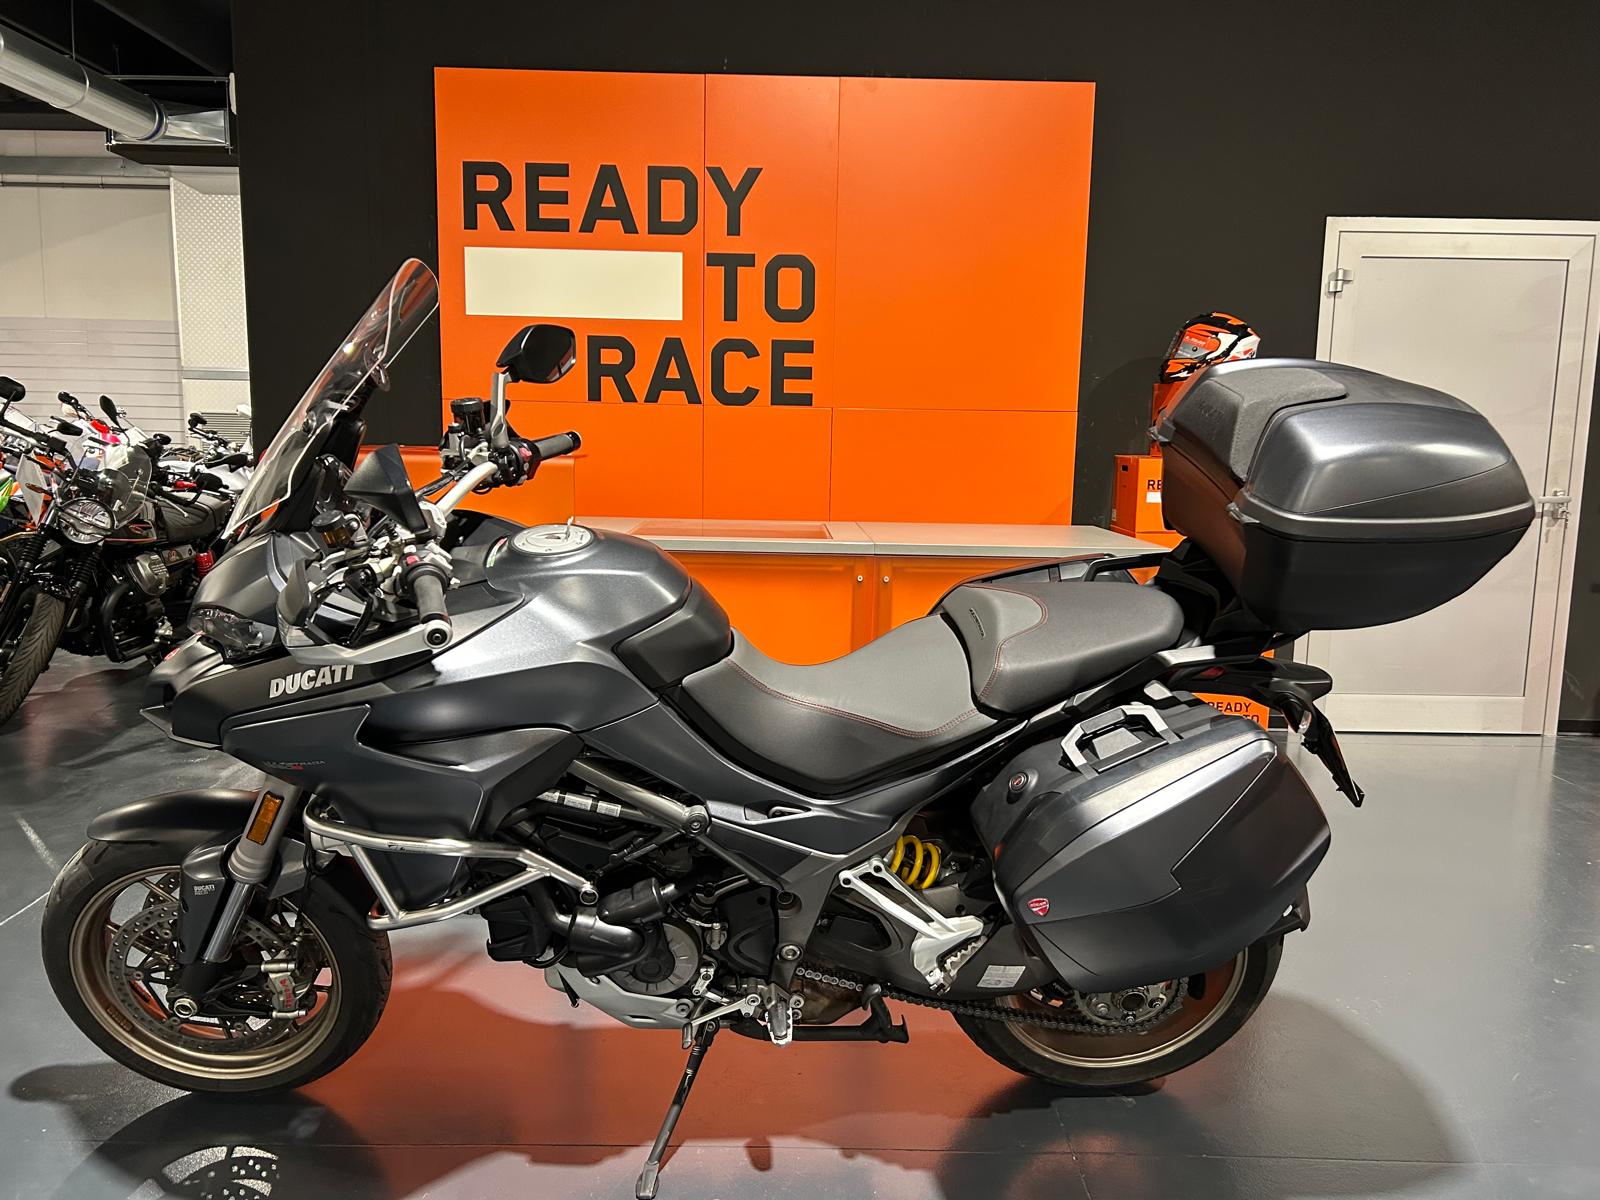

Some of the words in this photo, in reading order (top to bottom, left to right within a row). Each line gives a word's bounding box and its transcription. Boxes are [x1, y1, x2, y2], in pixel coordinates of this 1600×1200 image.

[462, 161, 763, 237] READY
[706, 253, 816, 323] TO
[586, 335, 815, 406] RACE
[269, 664, 355, 699] DUCATI
